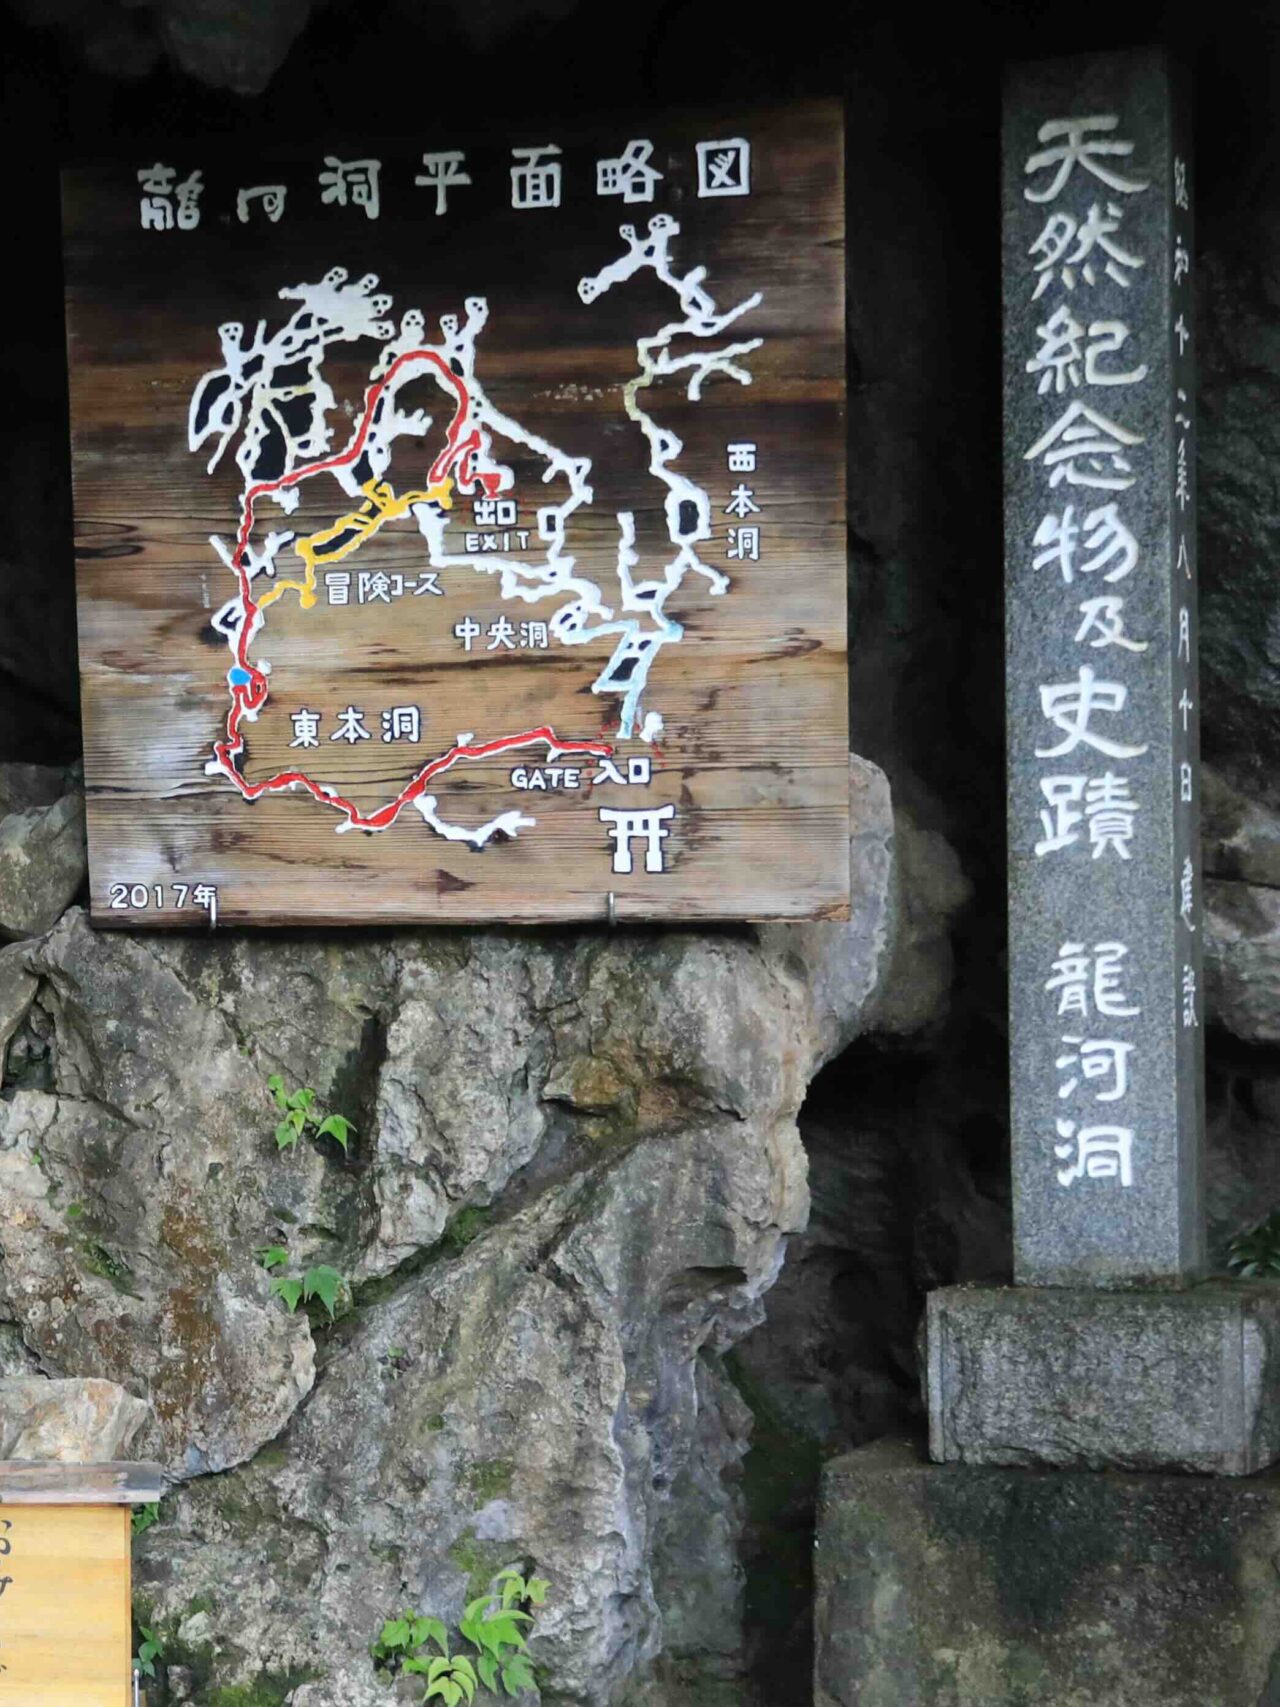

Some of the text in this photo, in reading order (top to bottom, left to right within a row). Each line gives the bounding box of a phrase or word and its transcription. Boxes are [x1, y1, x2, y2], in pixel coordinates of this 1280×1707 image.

[473, 500, 519, 526] 出口
[724, 442, 761, 561] 西本洞
[465, 531, 530, 552] EXIT
[324, 571, 444, 605] 冒険コース
[453, 615, 549, 652] 中央洞
[289, 705, 421, 748] 東本洞
[510, 757, 653, 790] GATE 入口
[110, 883, 217, 909] 2017年
